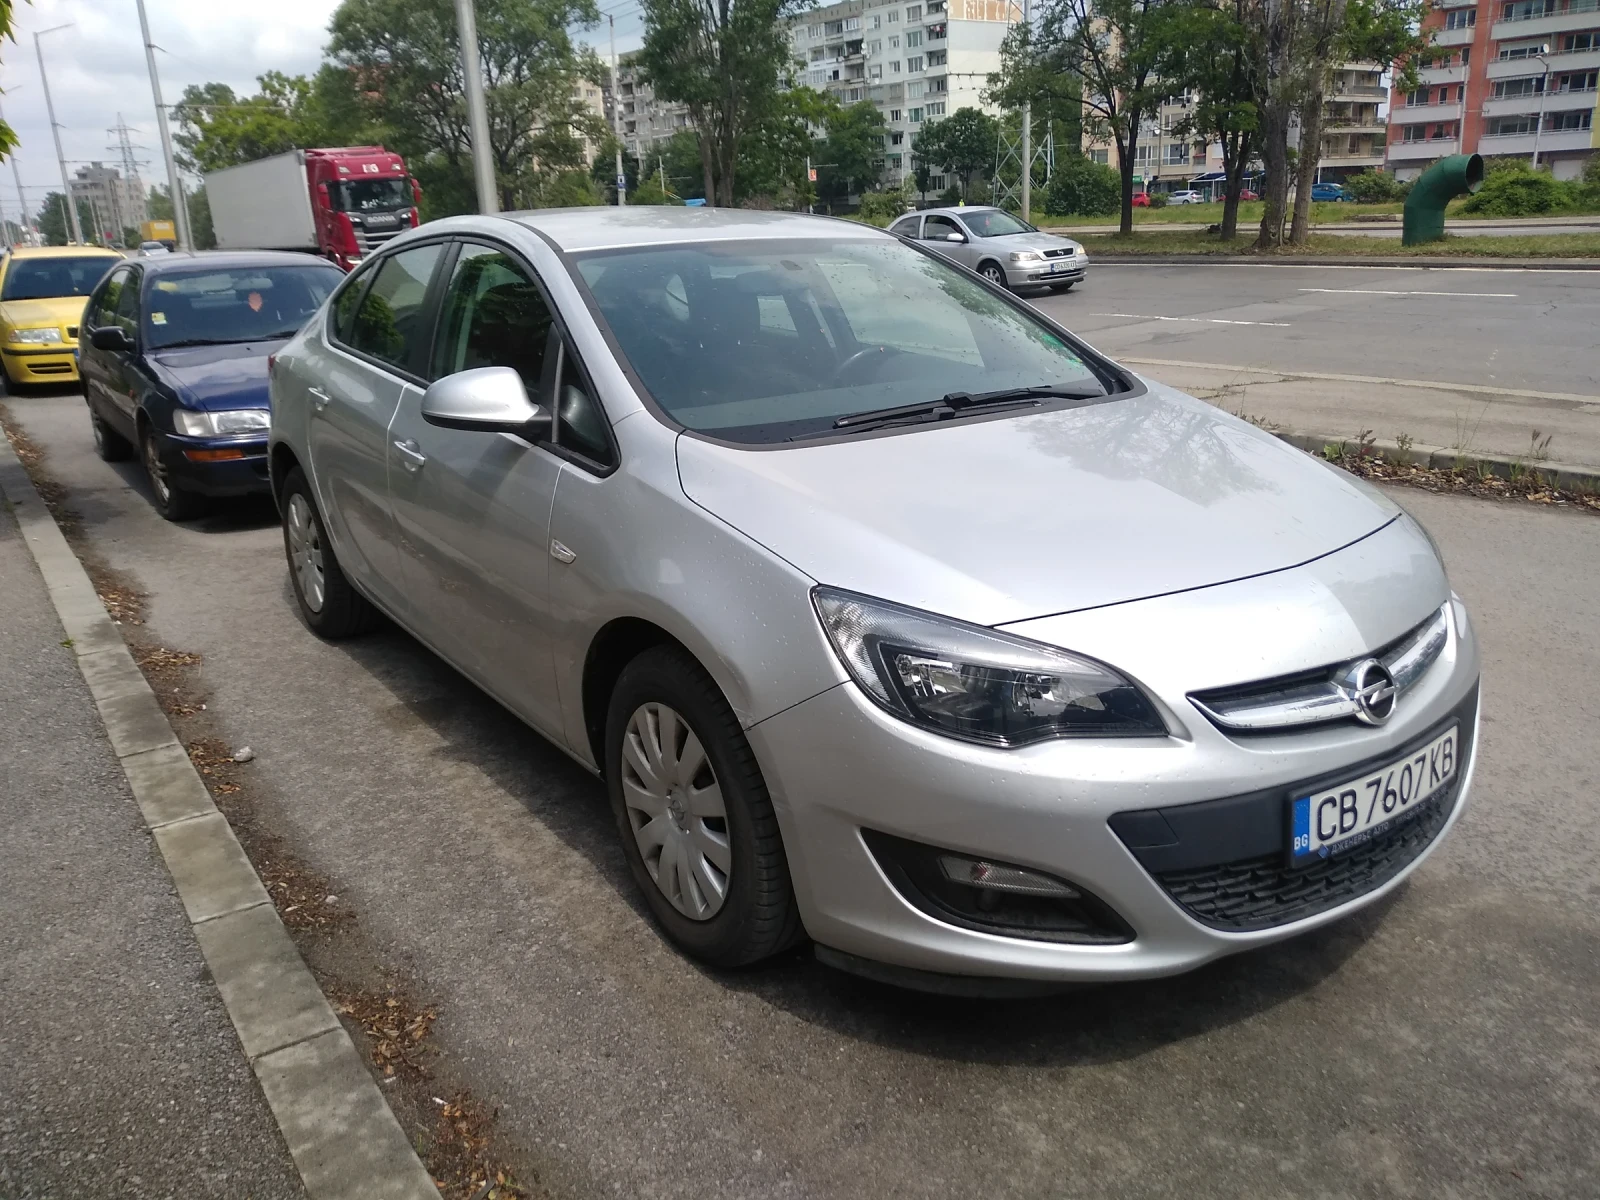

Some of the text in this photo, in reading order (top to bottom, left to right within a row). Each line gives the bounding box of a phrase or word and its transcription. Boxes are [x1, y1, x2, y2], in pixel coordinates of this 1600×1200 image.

[367, 215, 396, 223] SCANIA
[1317, 735, 1453, 842] CB 7607 KB
[1294, 833, 1309, 850] BG
